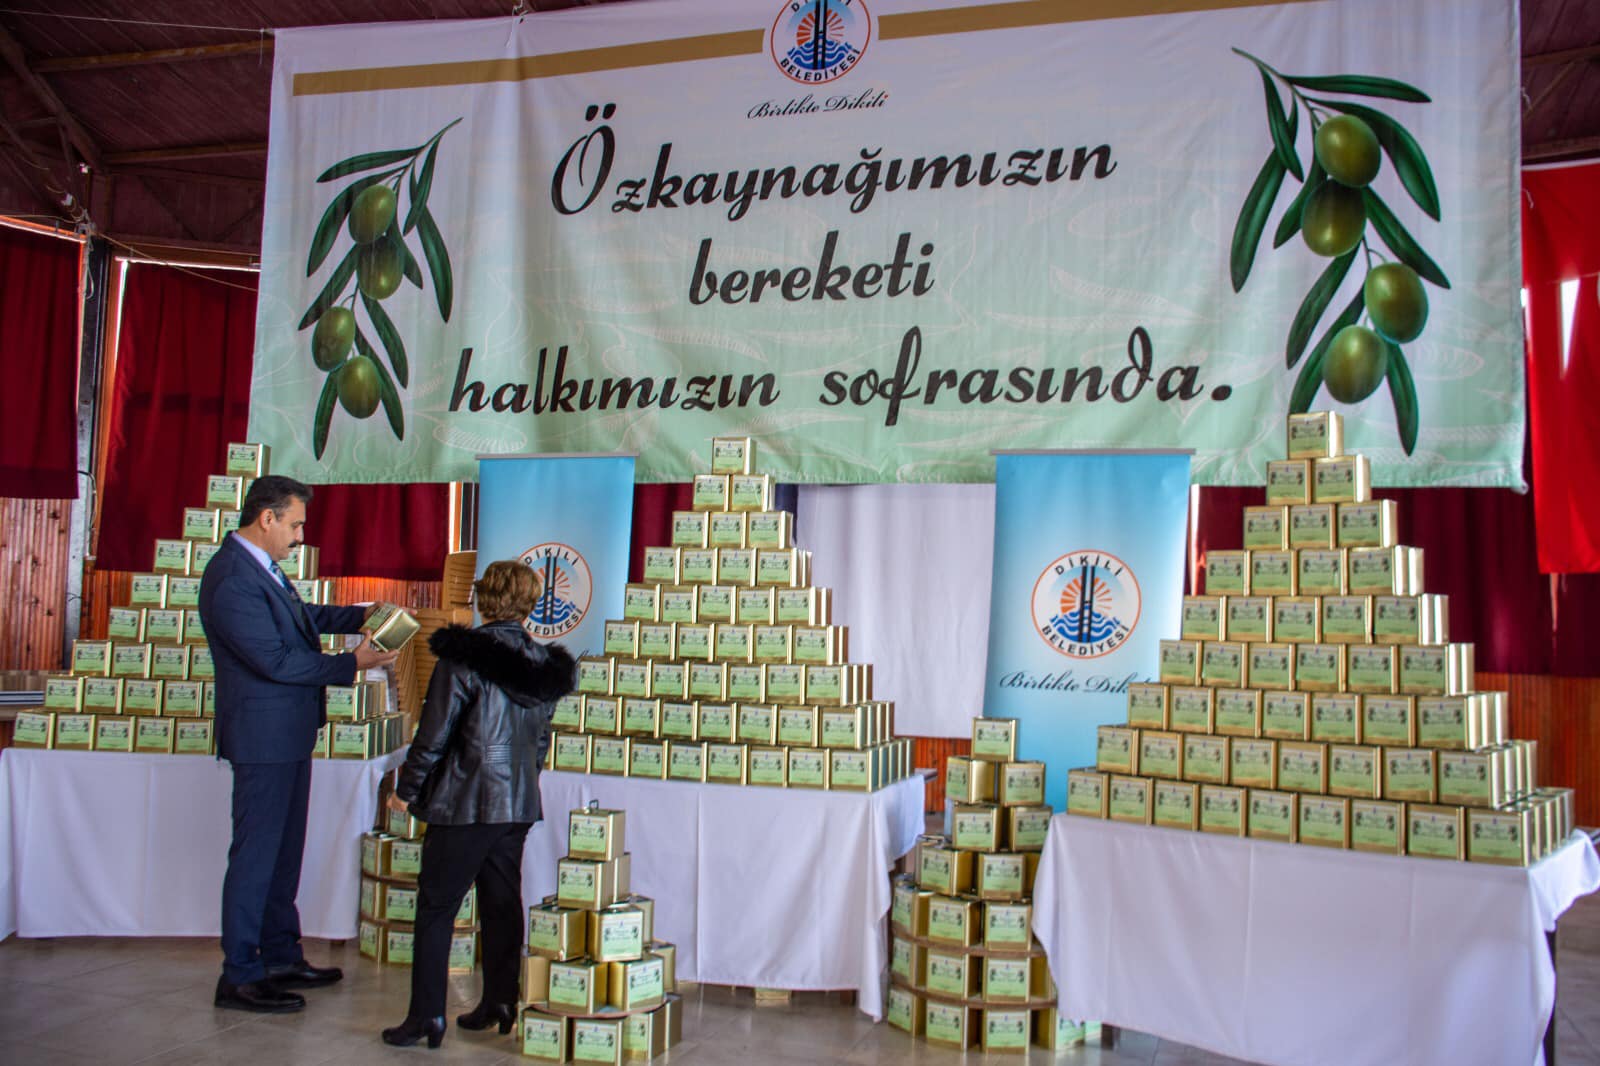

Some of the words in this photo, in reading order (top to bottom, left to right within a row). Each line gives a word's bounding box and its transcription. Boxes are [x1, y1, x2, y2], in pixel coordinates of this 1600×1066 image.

[747, 93, 820, 119] Birlikte
[823, 88, 889, 112] Dikili
[550, 103, 1118, 221] Özkaynağımızın
[688, 230, 935, 305] bereketi
[448, 346, 780, 414] halkımızın
[819, 325, 1233, 426] sofrasında.
[1054, 555, 1124, 577] DİKİLİ
[525, 608, 583, 636] LEDİYESİ
[999, 669, 1081, 693] Birlikte
